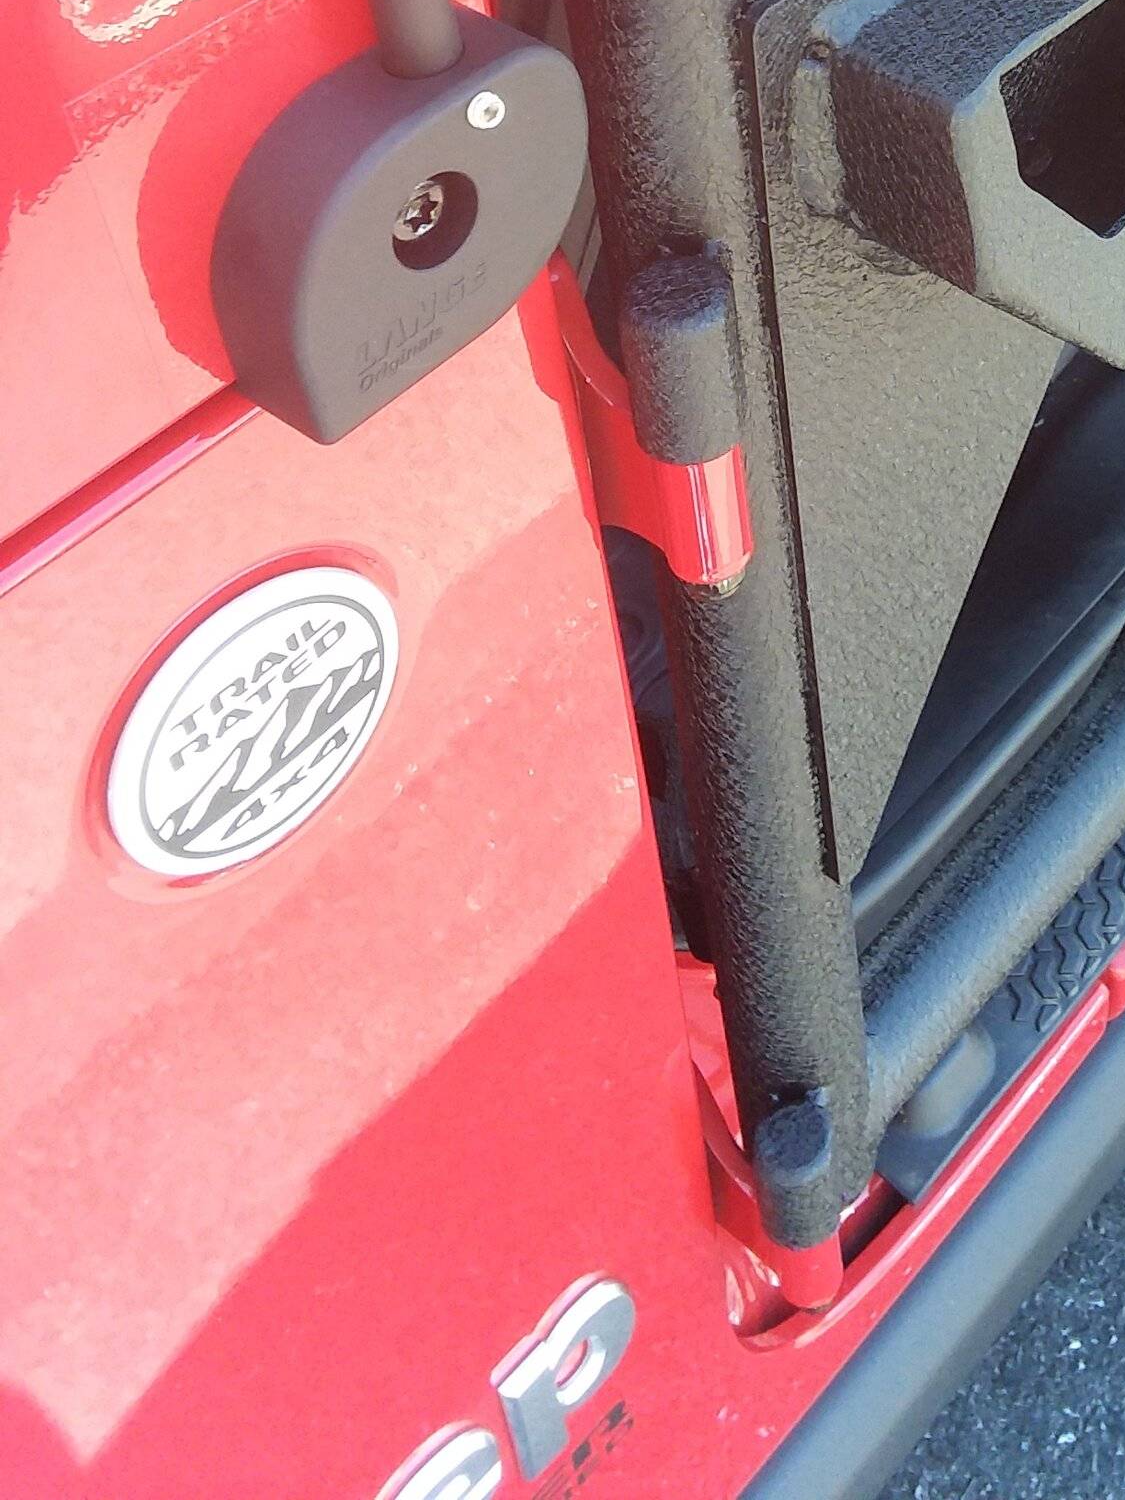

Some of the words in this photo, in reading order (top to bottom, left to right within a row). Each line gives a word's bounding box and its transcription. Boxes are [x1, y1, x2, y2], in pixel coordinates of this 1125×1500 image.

[168, 620, 347, 773] RATED
[170, 619, 331, 736] TRAIL
[220, 726, 350, 841] 4x4
